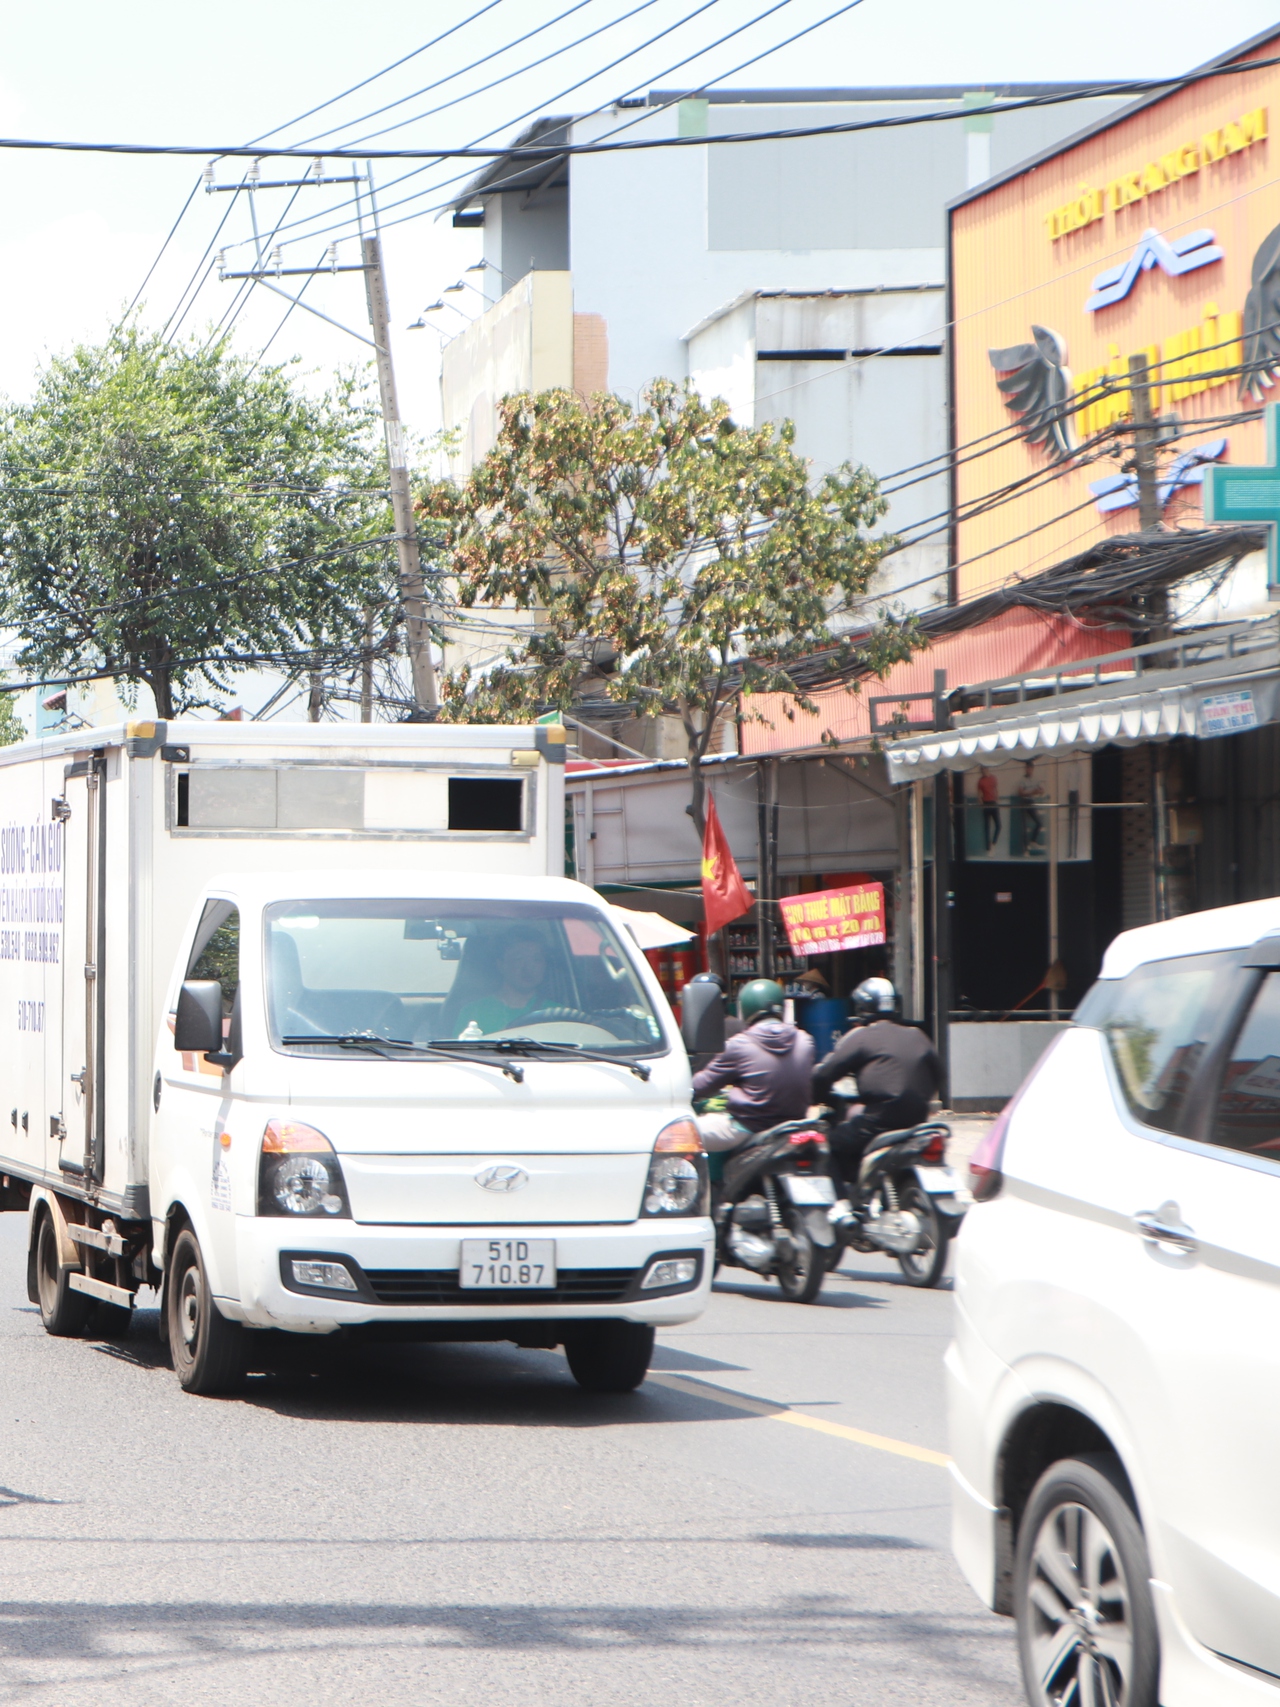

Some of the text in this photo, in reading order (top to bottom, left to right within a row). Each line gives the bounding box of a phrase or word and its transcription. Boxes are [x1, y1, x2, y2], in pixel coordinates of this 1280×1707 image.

[1201, 106, 1269, 167] NAM
[489, 1241, 528, 1261] 51D
[472, 1264, 545, 1284] 710.87
